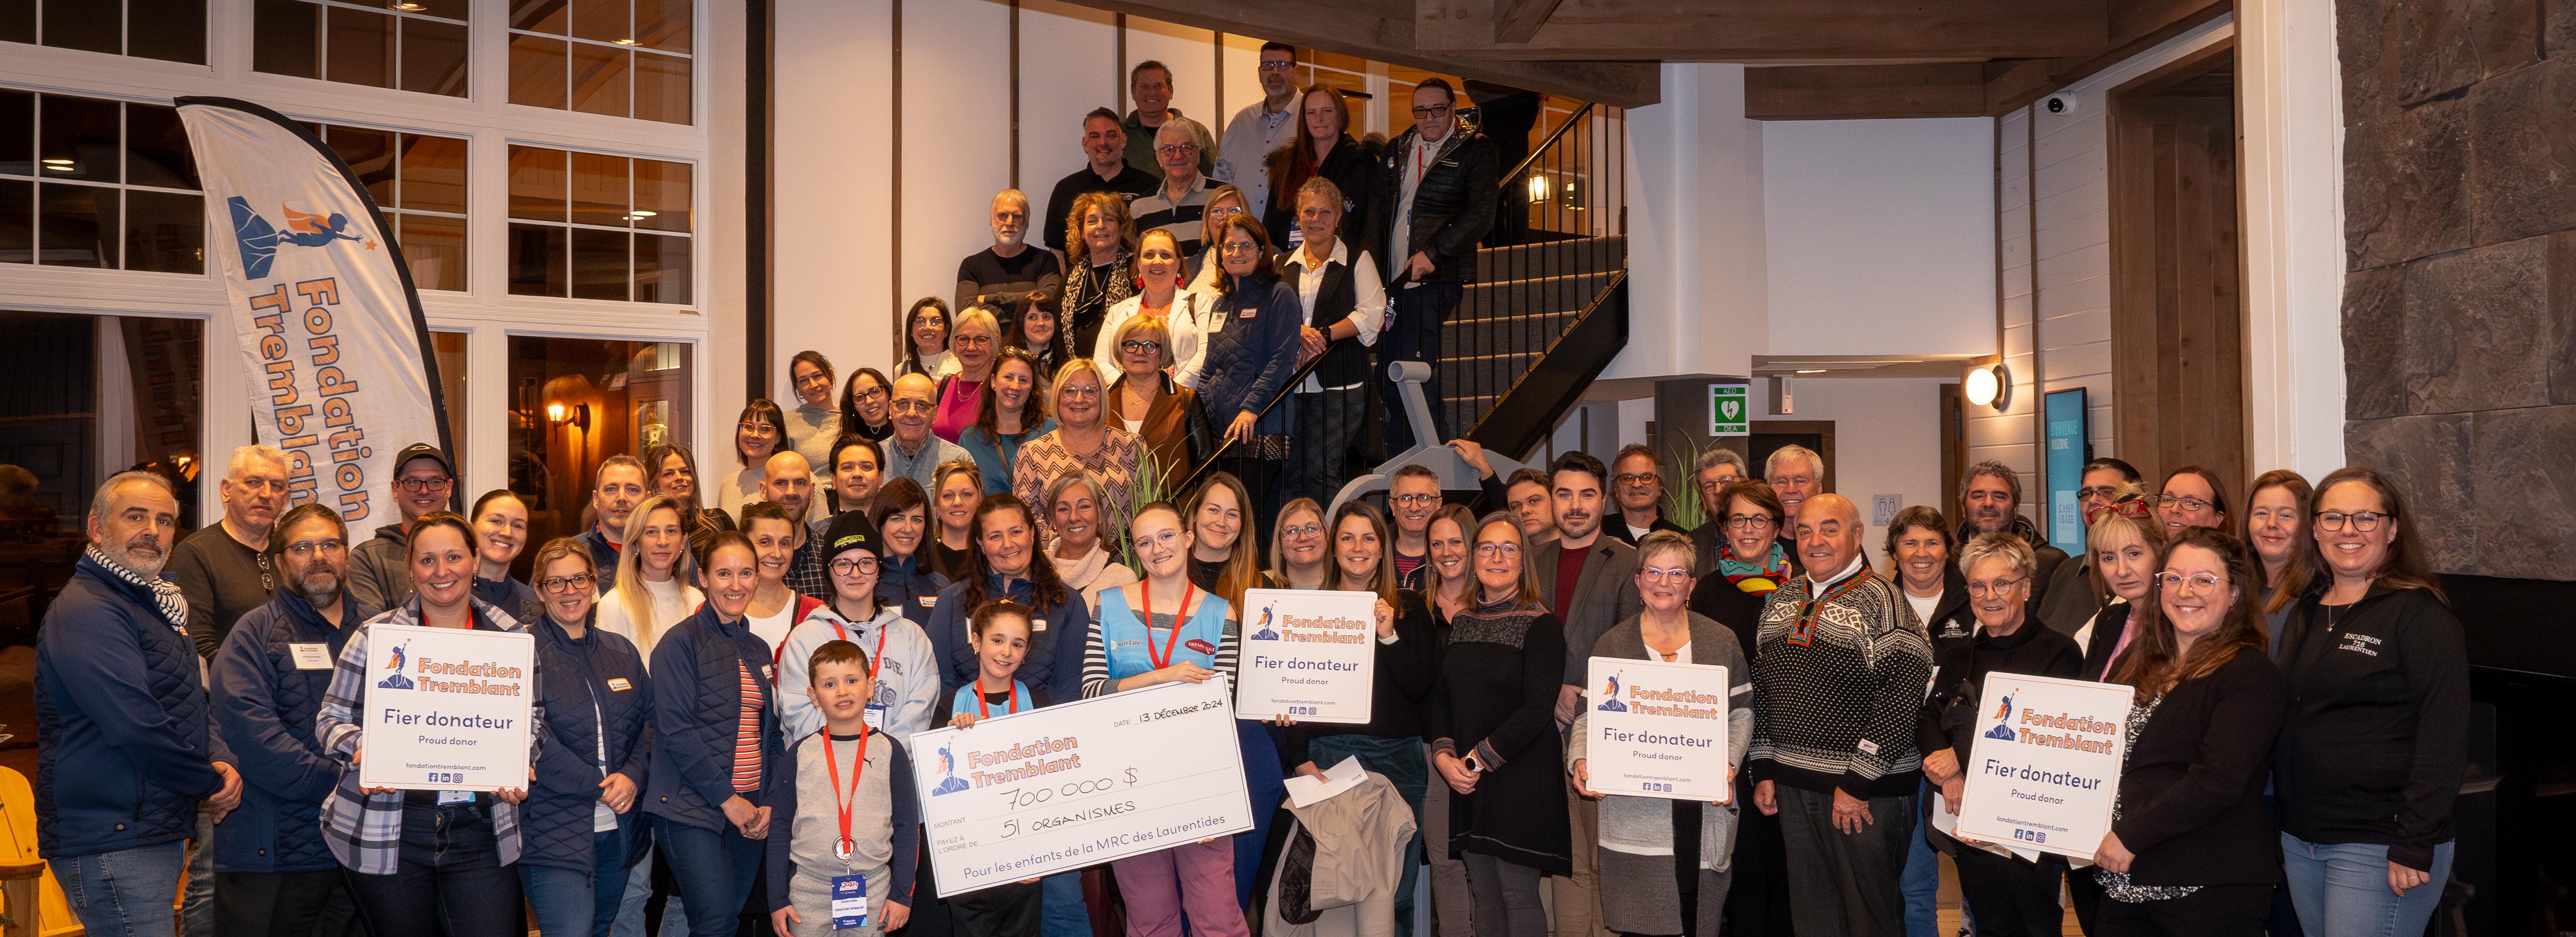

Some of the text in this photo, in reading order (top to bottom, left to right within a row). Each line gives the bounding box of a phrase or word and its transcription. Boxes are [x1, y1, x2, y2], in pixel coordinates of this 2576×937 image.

[249, 283, 319, 508] Tremblan
[296, 277, 372, 522] Fondation
[835, 536, 863, 545] ISOLATION
[1282, 615, 1366, 630] Fondation
[1282, 630, 1365, 644] Tremblant
[2343, 633, 2382, 645] ESCADRON
[2339, 644, 2377, 656] LAURENTIEN
[418, 657, 521, 679] Fondation
[1255, 656, 1358, 671] Fier donateur
[417, 676, 520, 697] Tremblant
[1630, 685, 1718, 704] Fondation
[384, 708, 513, 729] Fier donateur
[1140, 699, 1223, 723] 13 DÉCEMBRE 2024
[1630, 701, 1717, 720] Tremblant
[1114, 719, 1131, 728] DATE
[2021, 708, 2116, 735] Fondation
[419, 736, 477, 746] Proud donor
[1604, 727, 1712, 748] Fier donateur
[2019, 728, 2113, 755] Tremblant
[968, 736, 1078, 769] Fondation
[1633, 751, 1683, 761] Proud donor
[406, 763, 486, 771] fondationtremblant.com
[971, 754, 1081, 788] Tremblant
[1985, 759, 2101, 790] Fier donateur
[1000, 765, 1138, 810] 700 000 $
[1623, 773, 1691, 783] fondationtremblant.com
[2011, 789, 2064, 805] Proud donor
[934, 817, 967, 829] MONTANT
[1001, 801, 1136, 838] 51 ORGANISMES
[1996, 816, 2068, 833] fondationtremblant.com
[937, 836, 958, 846] PAYEZ
[938, 843, 968, 854] L'ORDRE
[964, 815, 1226, 879] Pour les enfants de la MRC des Laurentides
